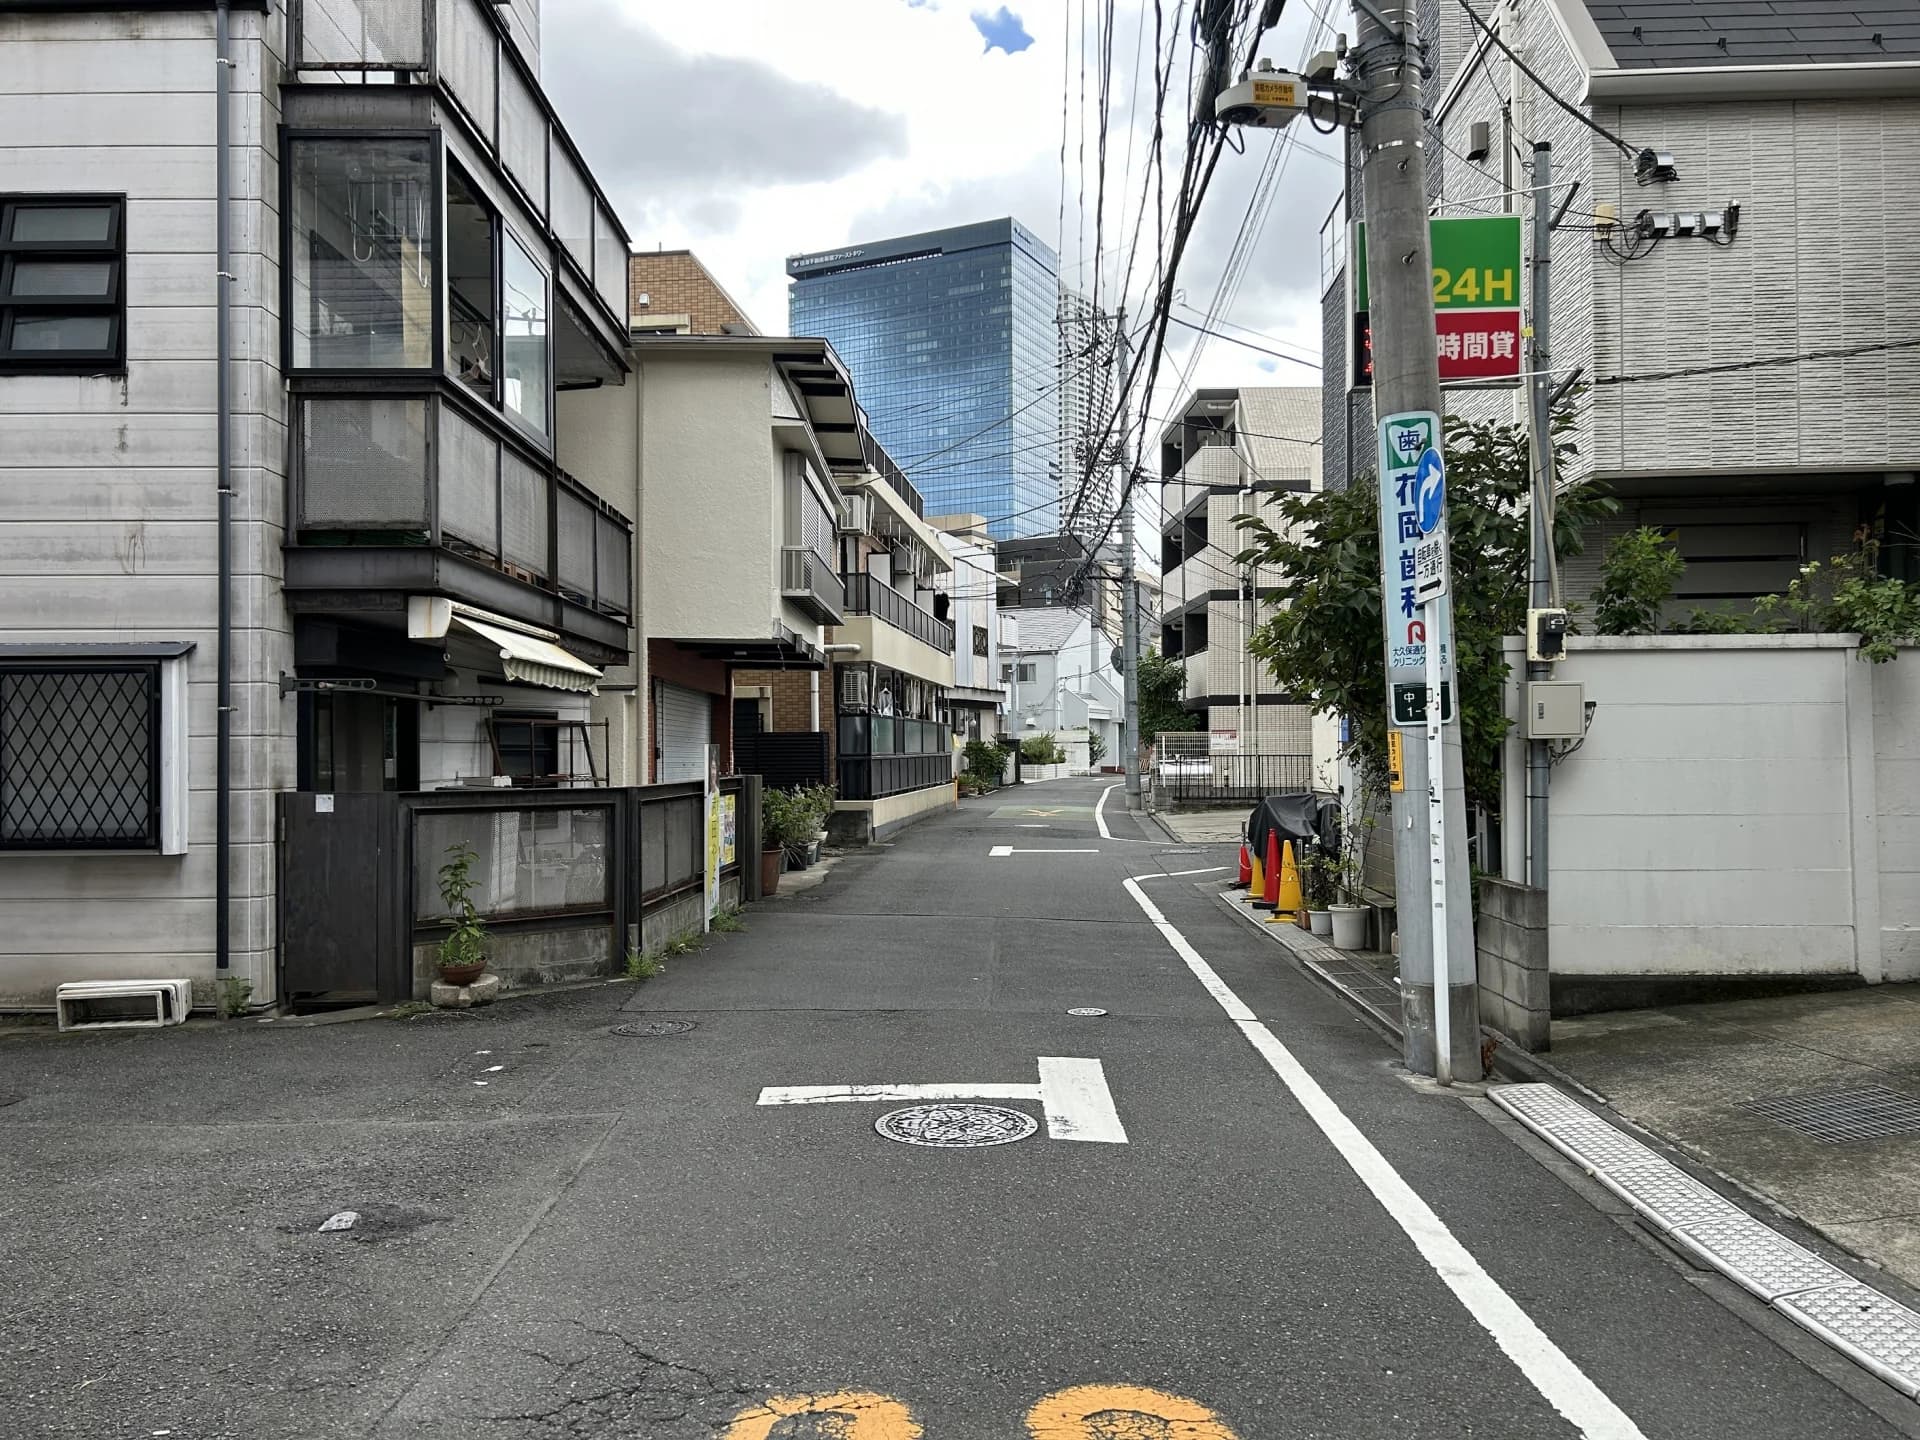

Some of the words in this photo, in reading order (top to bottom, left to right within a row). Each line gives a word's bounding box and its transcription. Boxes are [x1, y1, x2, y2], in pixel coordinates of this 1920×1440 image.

[1432, 267, 1513, 303] 24H
[1437, 331, 1516, 361] 時間貸
[1397, 430, 1420, 453] 歯
[1418, 557, 1443, 579] 一方通行
[1403, 692, 1416, 703] 中
[1407, 706, 1422, 718] 1-
